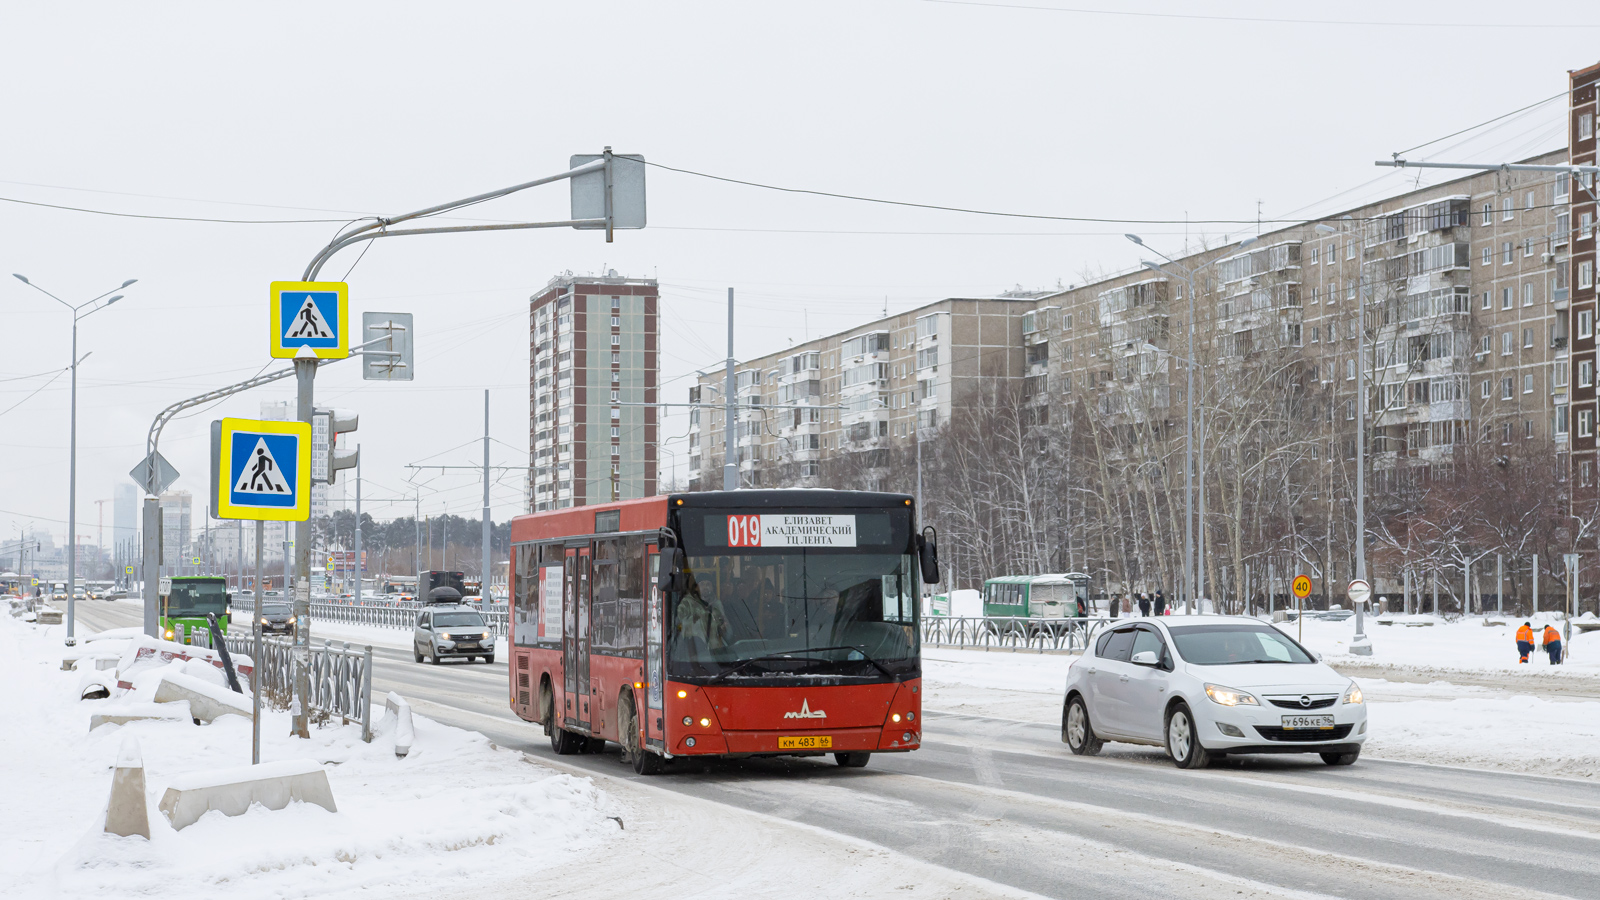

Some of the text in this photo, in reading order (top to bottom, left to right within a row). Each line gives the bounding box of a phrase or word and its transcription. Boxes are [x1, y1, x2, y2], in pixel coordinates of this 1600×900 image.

[784, 516, 833, 525] ЕЛИЗАВЕТ
[729, 516, 760, 546] 019
[765, 525, 852, 535] АКАДЕМИЧЕСКИЙ
[785, 536, 833, 546] ТЦ ЛЕНТА
[1295, 582, 1308, 591] 40
